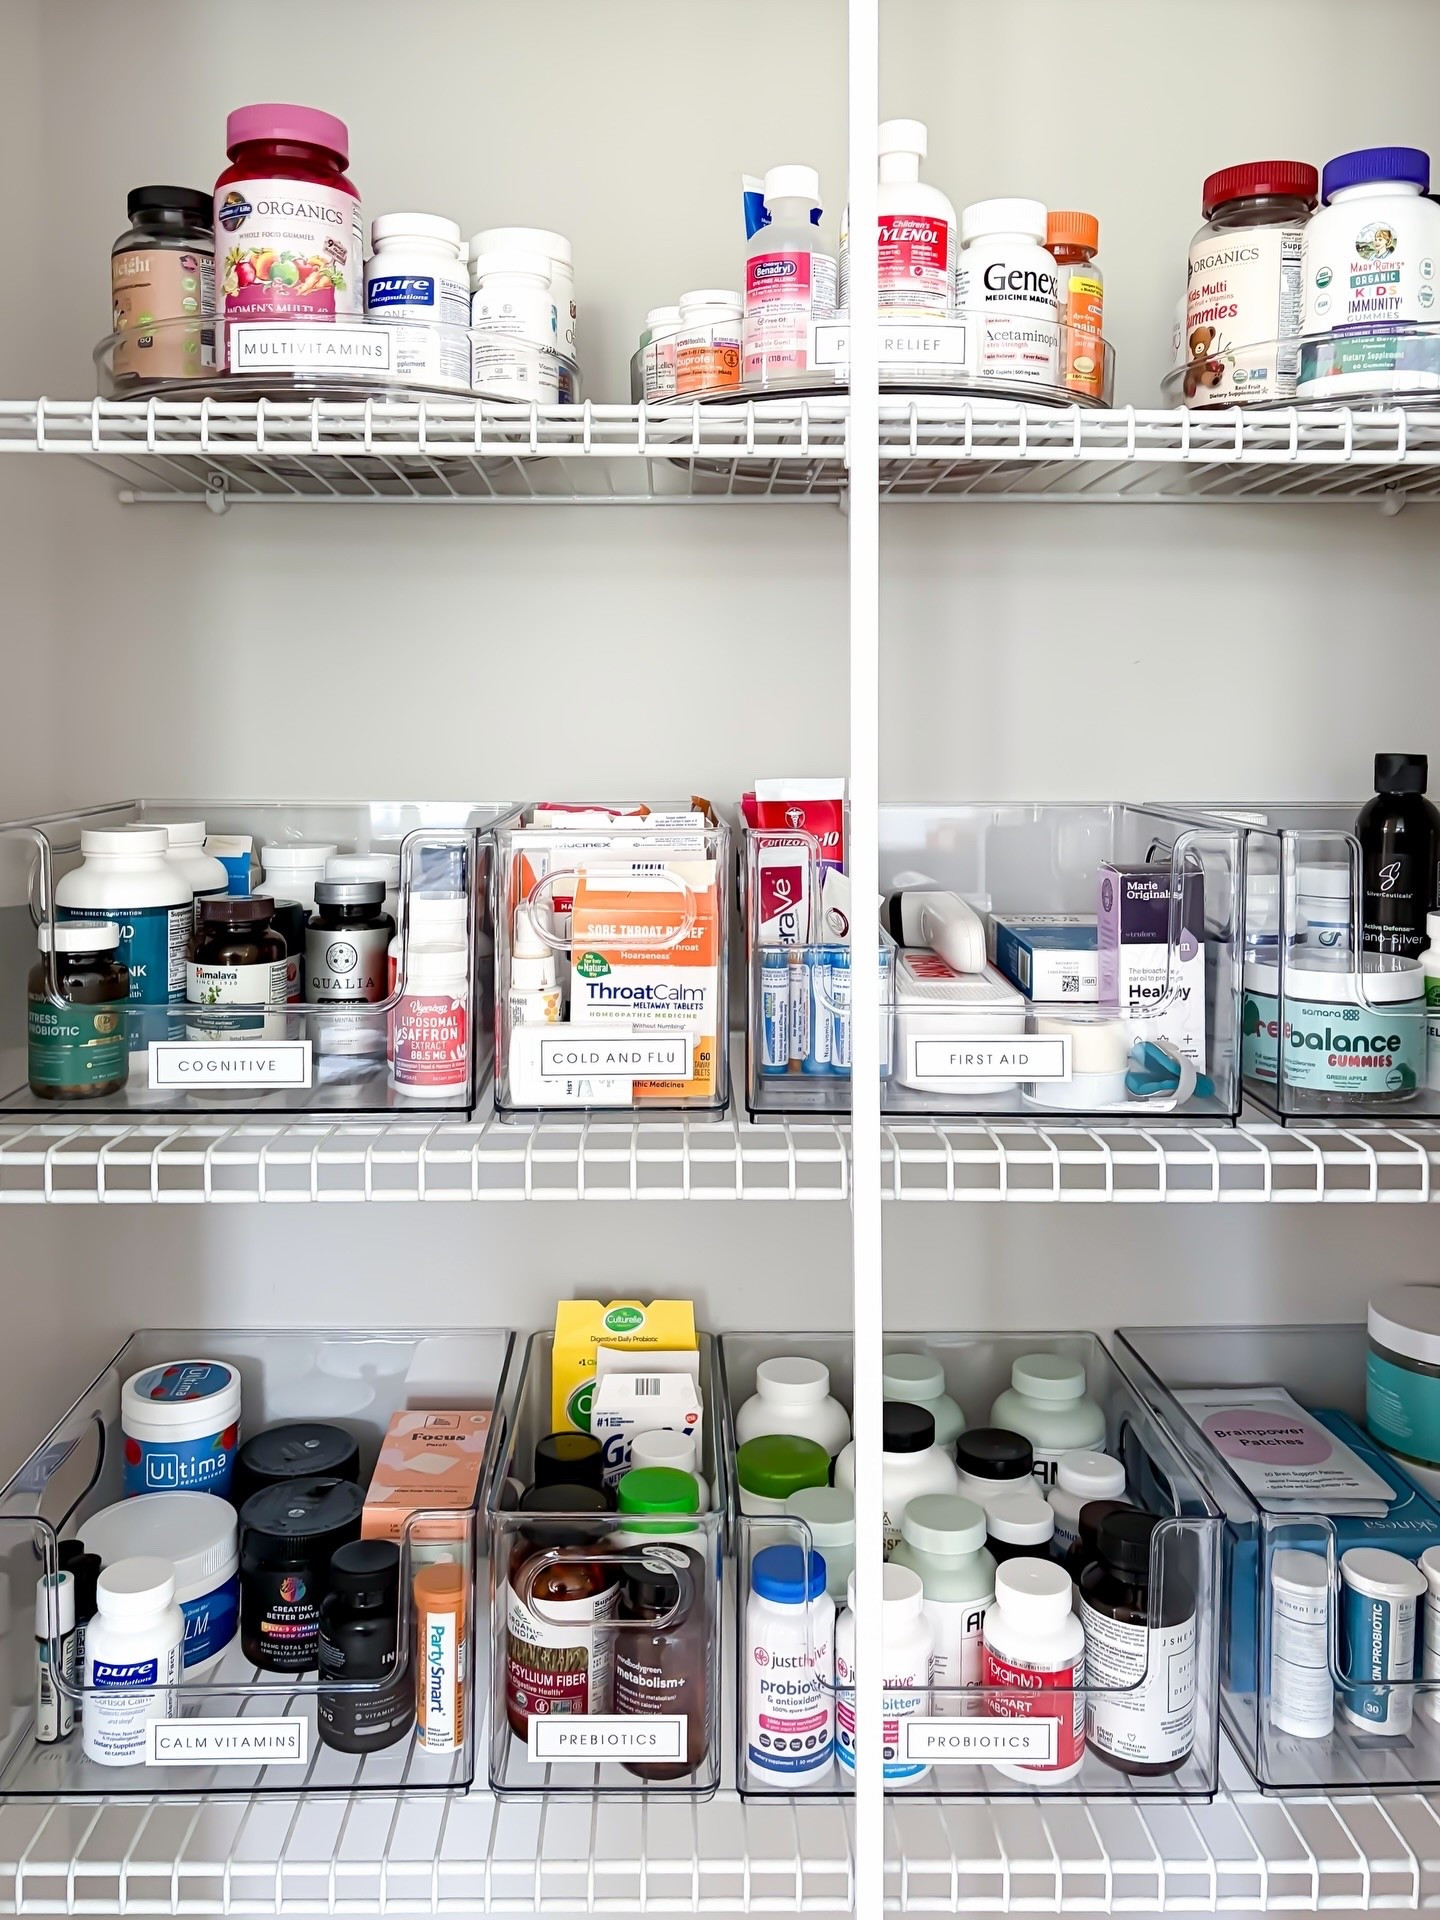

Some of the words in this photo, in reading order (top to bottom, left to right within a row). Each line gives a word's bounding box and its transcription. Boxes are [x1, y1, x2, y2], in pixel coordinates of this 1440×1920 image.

[256, 201, 344, 226] ORGANICS
[892, 219, 931, 230] Children's
[1193, 248, 1260, 273] ORGANICS
[757, 264, 792, 277] Benadryl
[1355, 271, 1397, 287] ORGANIC
[371, 278, 430, 297] pure
[1201, 279, 1228, 297] Multi
[1355, 286, 1398, 298] KIDS
[369, 293, 430, 305] encapsulations
[984, 293, 1028, 302] MEDICINE
[1028, 294, 1049, 305] MADE
[1348, 296, 1402, 314] IMMUNITY
[1346, 311, 1400, 323] GUMMIES
[244, 341, 384, 357] MULTIVITAMINS
[885, 338, 942, 351] RELIEF
[982, 368, 995, 376] 100
[1127, 881, 1159, 891] Marie
[587, 924, 616, 938] SORE
[622, 925, 664, 938] THROAT
[1364, 923, 1382, 931] Active
[1382, 924, 1411, 932] Defense
[195, 966, 238, 980] Himalaya
[584, 963, 609, 973] Natural
[1128, 967, 1141, 975] The
[312, 976, 376, 991] QUALIA
[586, 982, 704, 1002] ThroatCalm
[632, 1002, 671, 1010] MELTAWAY
[673, 1002, 704, 1010] TABLETS
[589, 1011, 653, 1019] HOMEOPATHIC
[654, 1012, 698, 1020] MEDICINE
[1302, 1007, 1342, 1018] samara
[401, 1016, 459, 1028] LIPOSOMAL
[401, 1026, 458, 1041] SAFFRON
[411, 1040, 447, 1050] EXTRACT
[432, 1051, 447, 1060] MG
[552, 1052, 600, 1065] COLD
[605, 1052, 643, 1064] AND
[647, 1051, 676, 1064] FLU
[699, 1052, 711, 1061] 60
[949, 1053, 993, 1065] FIRST
[999, 1053, 1030, 1065] AID
[1327, 1053, 1393, 1068] GUMMIES
[177, 1059, 276, 1072] COGNITIVE
[649, 1081, 685, 1089] Medicines
[606, 1313, 643, 1326] Culturelle
[590, 1335, 617, 1344] Digestive
[617, 1335, 632, 1344] Daily
[632, 1335, 659, 1343] Probiotic
[596, 1416, 610, 1428] #1
[411, 1431, 466, 1442] Focus
[1214, 1426, 1305, 1440] Brainpower
[1239, 1437, 1304, 1447] Patches
[148, 1452, 227, 1481] Ultima
[272, 1604, 314, 1613] CREATING
[266, 1612, 296, 1621] BETTER
[298, 1611, 320, 1620] DAYS
[511, 1624, 538, 1642] INDIA
[1373, 1603, 1383, 1663] PROBIOTIC
[280, 1643, 302, 1651] TOTAL
[97, 1662, 154, 1677] pure
[428, 1625, 447, 1714] PartySmart
[511, 1661, 554, 1687] PSYLLIUM
[556, 1672, 586, 1687] FIBER
[616, 1664, 686, 1691] metabolism+
[774, 1692, 822, 1706] antioxidant
[1365, 1704, 1379, 1713] 30
[93, 1738, 112, 1749] Dietary
[159, 1736, 208, 1750] CALM
[214, 1735, 296, 1749] VITAMINS
[559, 1733, 657, 1746] PREBIOTICS
[927, 1736, 1030, 1748] PROBIOTICS
